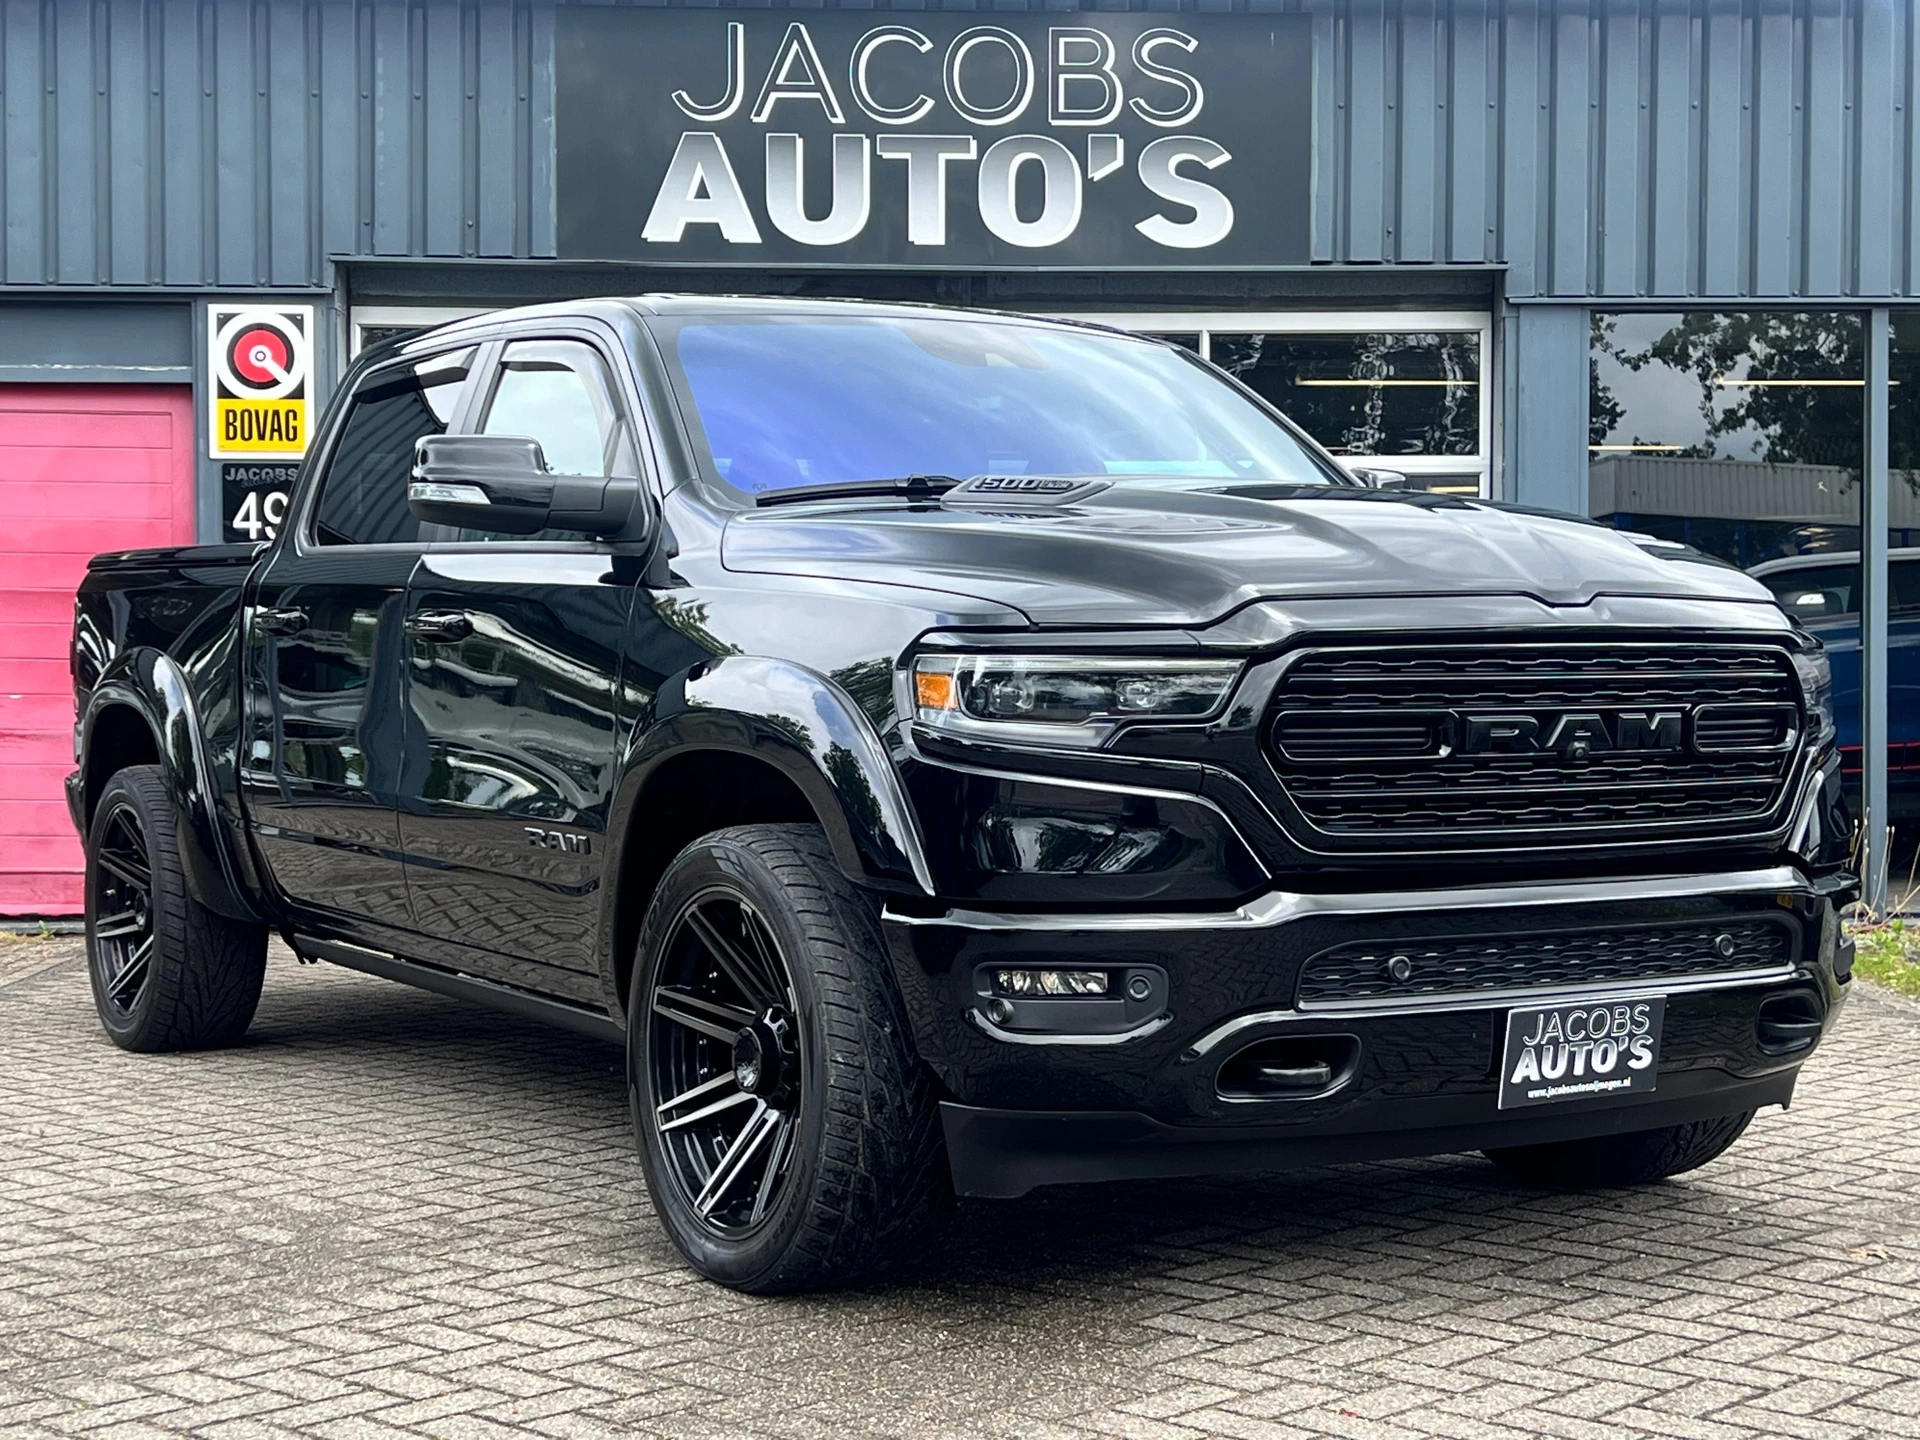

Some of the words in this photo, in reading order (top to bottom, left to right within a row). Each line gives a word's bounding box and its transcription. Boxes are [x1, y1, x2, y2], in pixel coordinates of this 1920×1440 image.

[671, 22, 1204, 127] JACOBS
[641, 132, 1234, 248] AUTO'S
[225, 408, 298, 442] BOVAG
[225, 467, 299, 482] JACOBS
[974, 477, 1038, 490] 1500
[232, 491, 288, 540] 49
[1466, 712, 1682, 751] RAM
[1522, 1003, 1651, 1046] JACOBS
[1510, 1034, 1654, 1084] AUTO'S
